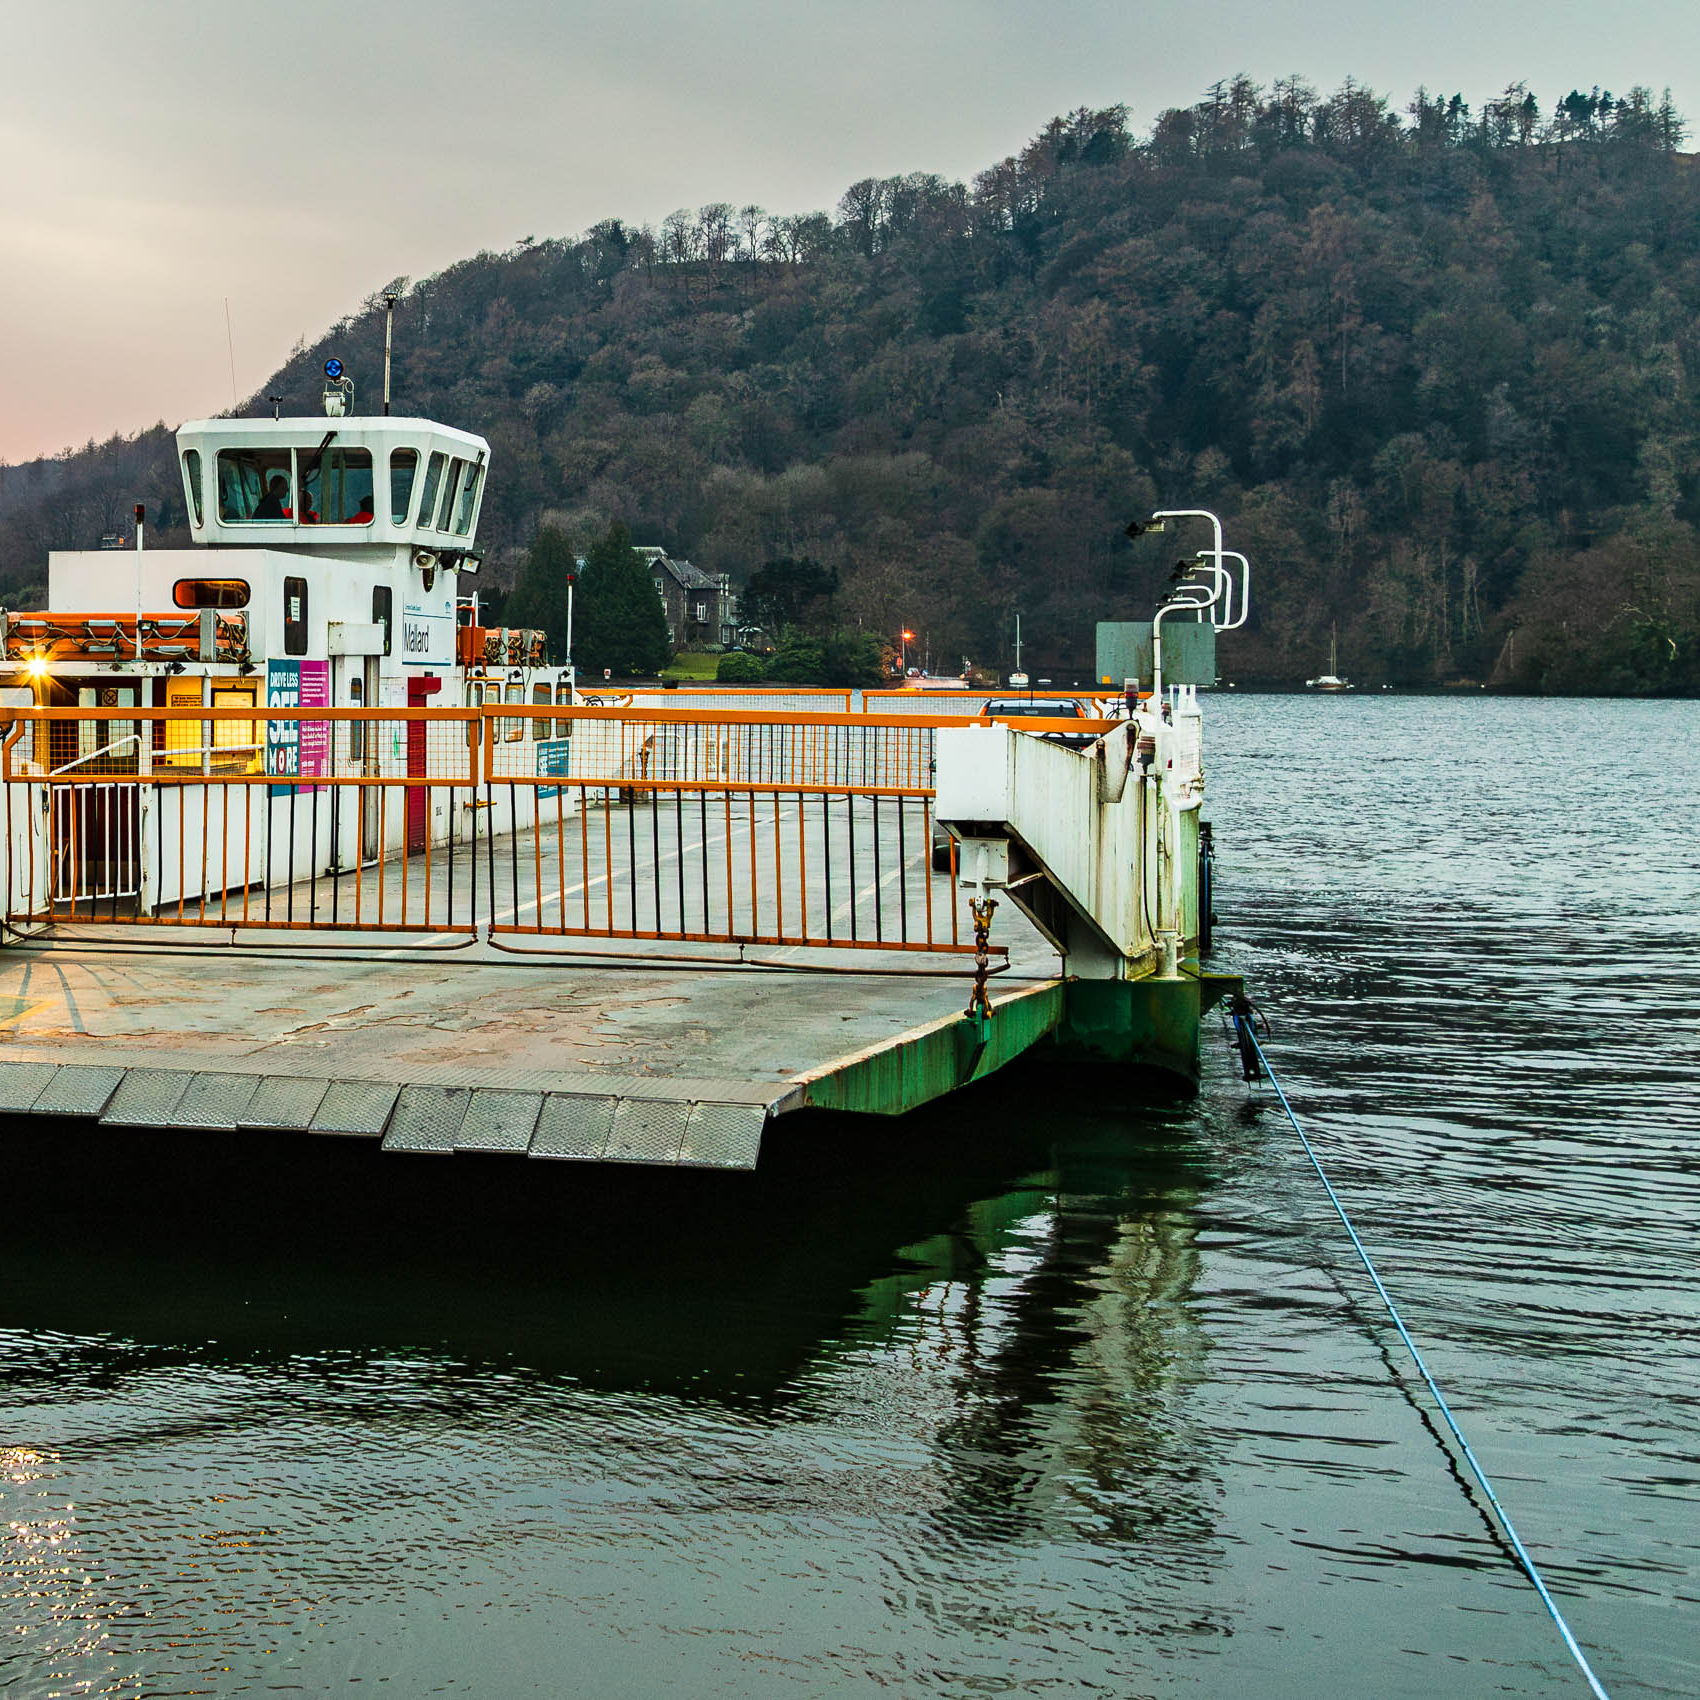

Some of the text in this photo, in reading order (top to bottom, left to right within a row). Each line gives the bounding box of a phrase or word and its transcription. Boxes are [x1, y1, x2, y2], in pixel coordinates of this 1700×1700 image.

[404, 622, 429, 653] Mallard
[287, 672, 298, 687] LESS
[269, 746, 298, 775] MORE
